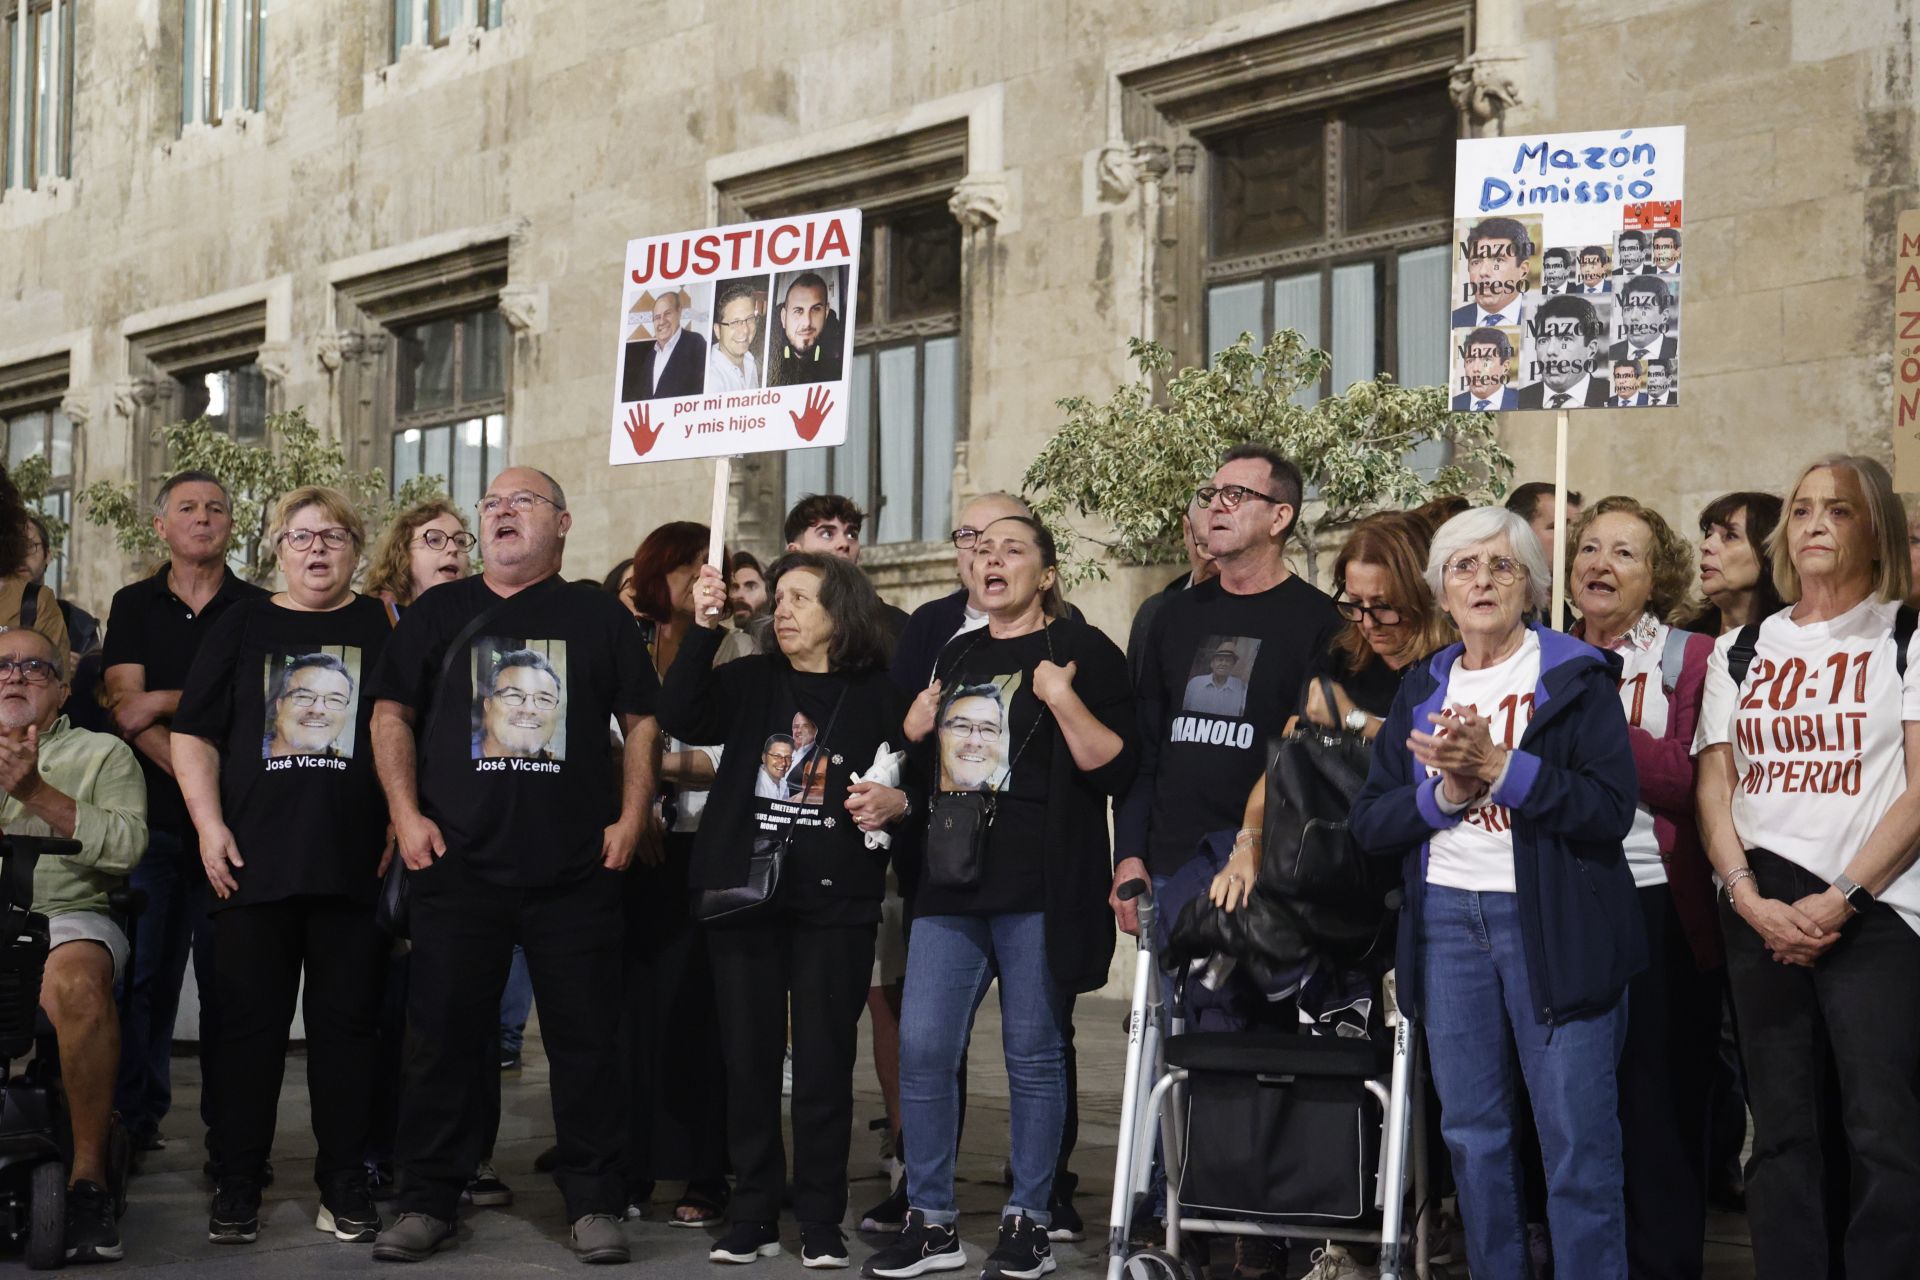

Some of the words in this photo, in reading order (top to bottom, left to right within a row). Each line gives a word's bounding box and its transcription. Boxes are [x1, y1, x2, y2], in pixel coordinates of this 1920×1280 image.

[1512, 129, 1656, 176] Mazón
[1478, 168, 1656, 212] Dimissió
[631, 218, 851, 284] JUSTICIA
[673, 399, 700, 418] por
[704, 393, 722, 411] mi
[726, 390, 782, 407] marido
[684, 422, 694, 439] y
[698, 417, 724, 433] mis
[729, 414, 766, 434] hijos
[1739, 651, 1873, 711] 20:11
[1170, 716, 1255, 750] MANOLO
[1736, 717, 1765, 756] NI
[1771, 712, 1867, 754] OBLIT
[265, 756, 293, 772] José
[296, 755, 347, 771] Vicente
[476, 757, 507, 772] José
[510, 758, 561, 774] Vicente
[1766, 752, 1863, 796] PERDÓ
